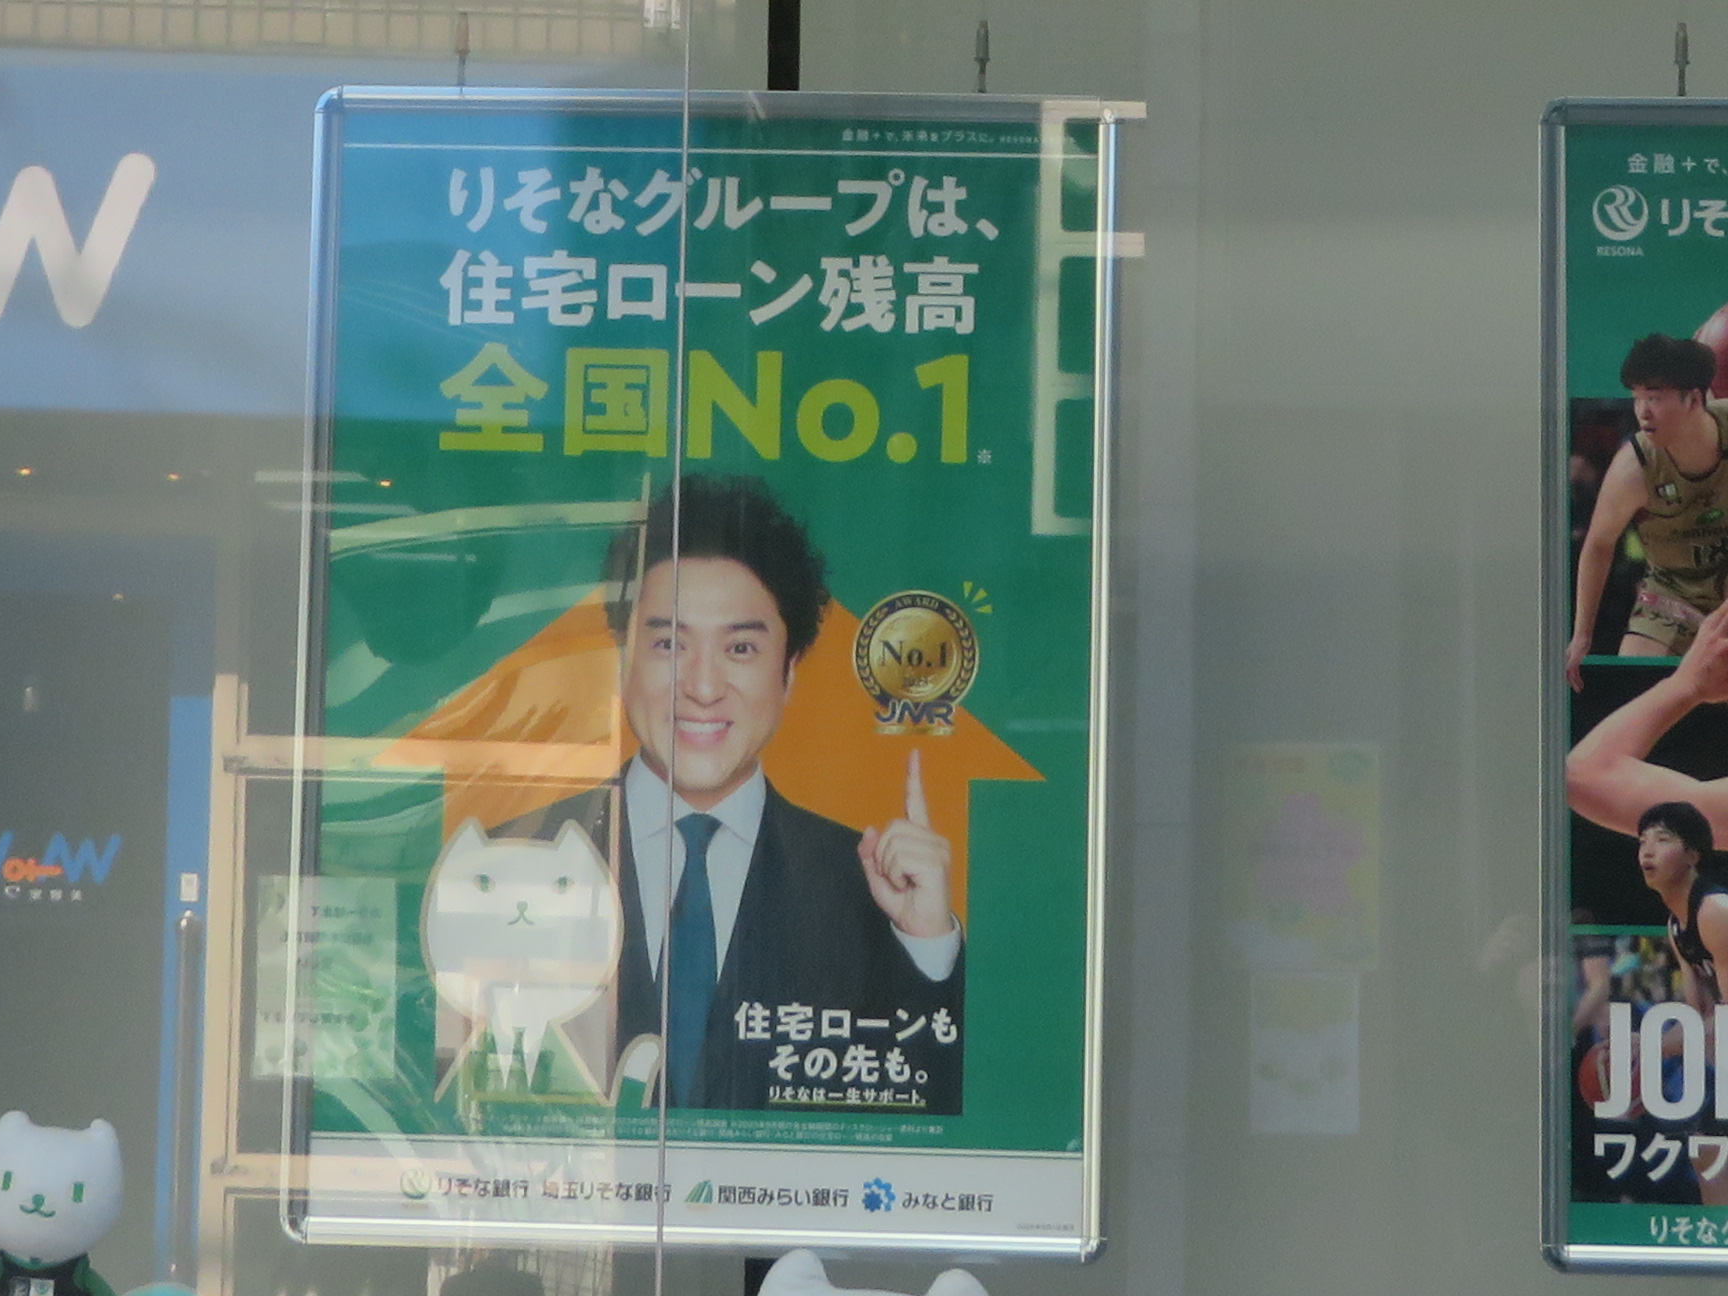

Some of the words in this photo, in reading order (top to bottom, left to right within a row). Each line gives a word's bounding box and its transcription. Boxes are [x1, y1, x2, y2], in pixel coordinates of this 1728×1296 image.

[449, 166, 1001, 241] りそなグループは、
[1596, 246, 1645, 256] RESONA
[439, 250, 979, 334] 住宅ローン残高
[735, 1002, 958, 1042] 住宅ローンも
[768, 1046, 930, 1085] その先も。
[768, 1086, 928, 1107] りそなは一生サポート。
[436, 1177, 529, 1199] りそな銀行
[718, 1185, 850, 1208] 関西みらい銀行
[902, 1193, 994, 1213] みなと銀行
